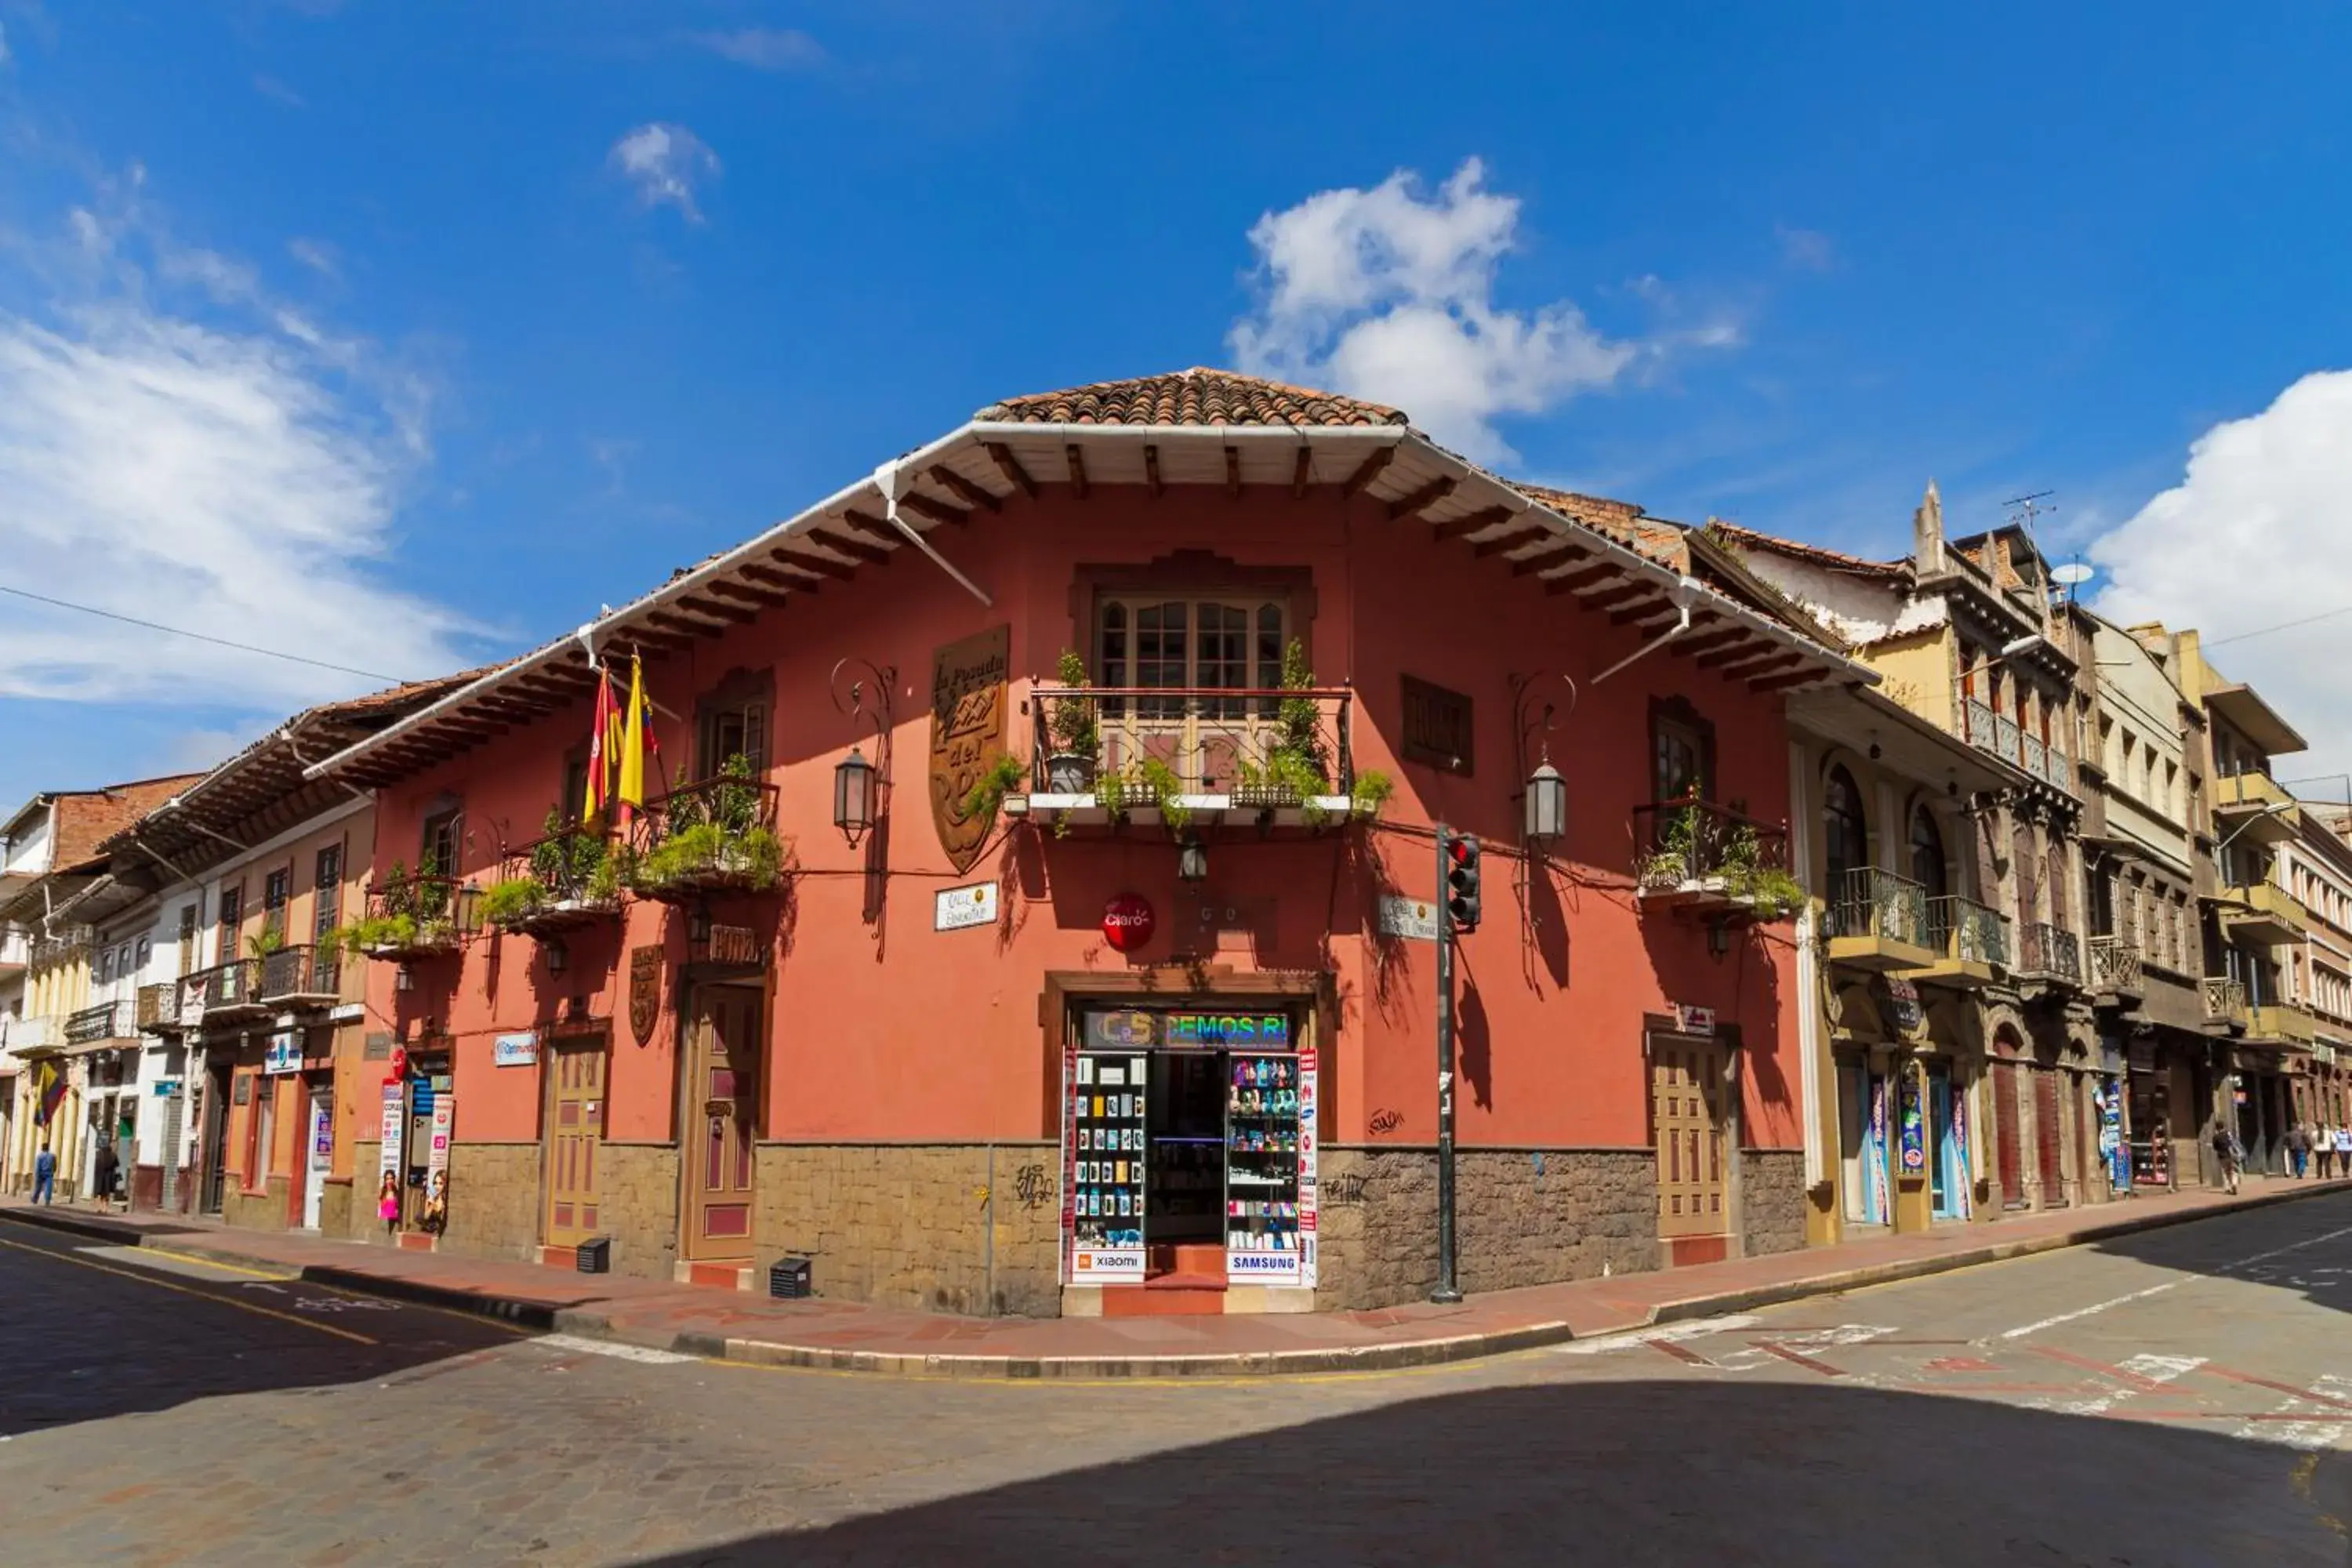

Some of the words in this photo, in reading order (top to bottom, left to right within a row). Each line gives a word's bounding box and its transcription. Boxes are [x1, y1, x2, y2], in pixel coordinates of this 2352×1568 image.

[951, 654, 1004, 687] Posada
[950, 739, 982, 768] del
[1105, 913, 1142, 926] Claro
[1233, 1256, 1294, 1269] SAMSUNG
